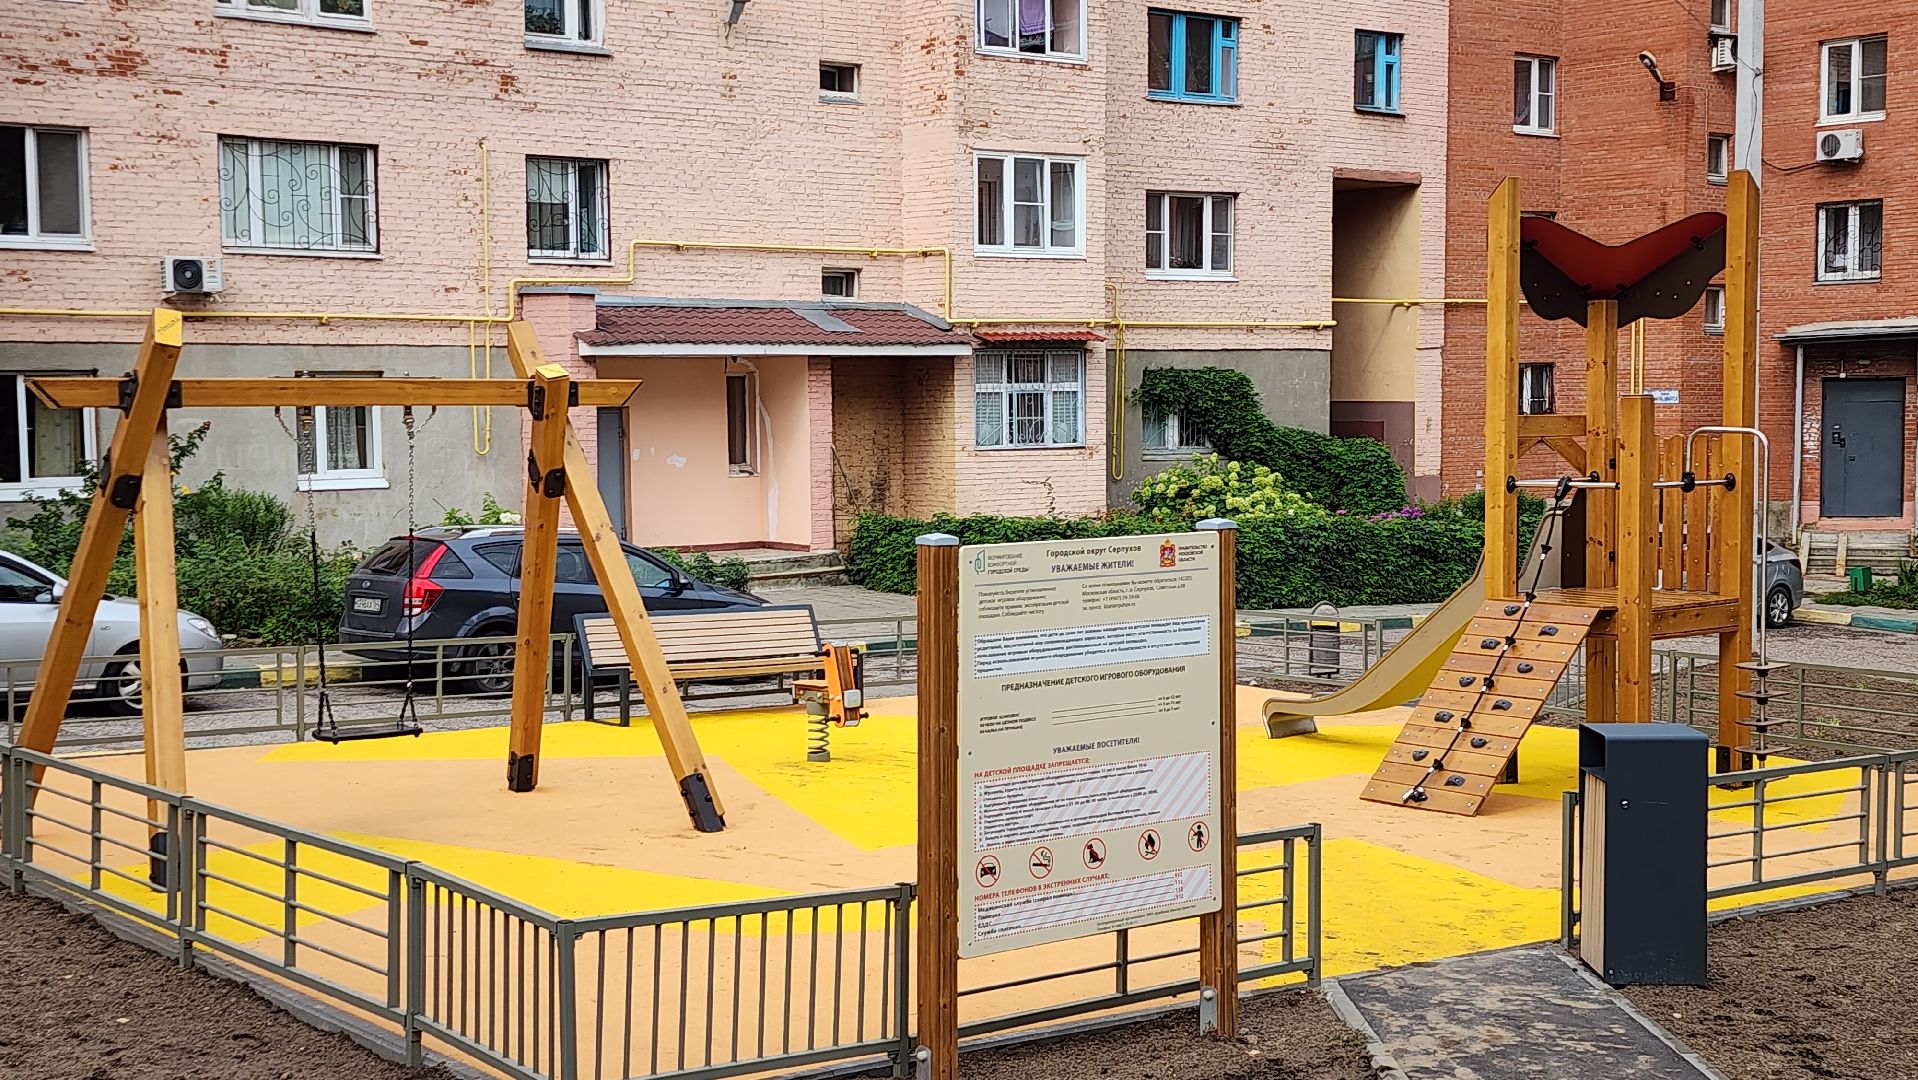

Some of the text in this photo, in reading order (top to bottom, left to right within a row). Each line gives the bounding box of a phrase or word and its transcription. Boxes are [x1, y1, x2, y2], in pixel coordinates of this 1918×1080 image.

[1046, 546, 1141, 559] Городской округ Серпухов
[1052, 560, 1134, 573] УВАЖАЕМЫЕ ЖИТЕЛИ!
[1001, 665, 1185, 692] ПРЕДНАЗНАЧЕНИЕ ДЕТСКОГО ИГРОВОГО ОБОРУДОВАНИЯ
[1053, 737, 1140, 754] УВАЖАЕМЫЕ ПОСЕТИТЕЛИ!
[984, 767, 1011, 778] ДЕТСКОЙ
[1013, 763, 1046, 774] ПЛОЩАДКЕ
[1048, 758, 1090, 768] ЗАПРЕЩАЕТСЯ:
[974, 893, 999, 902] НОМЕРА
[1001, 887, 1037, 896] ТЕЛЕФОНОВ
[1043, 877, 1080, 889] ЭКСТРЕННЫХ
[1082, 873, 1110, 882] СЛУЧАЯХ:
